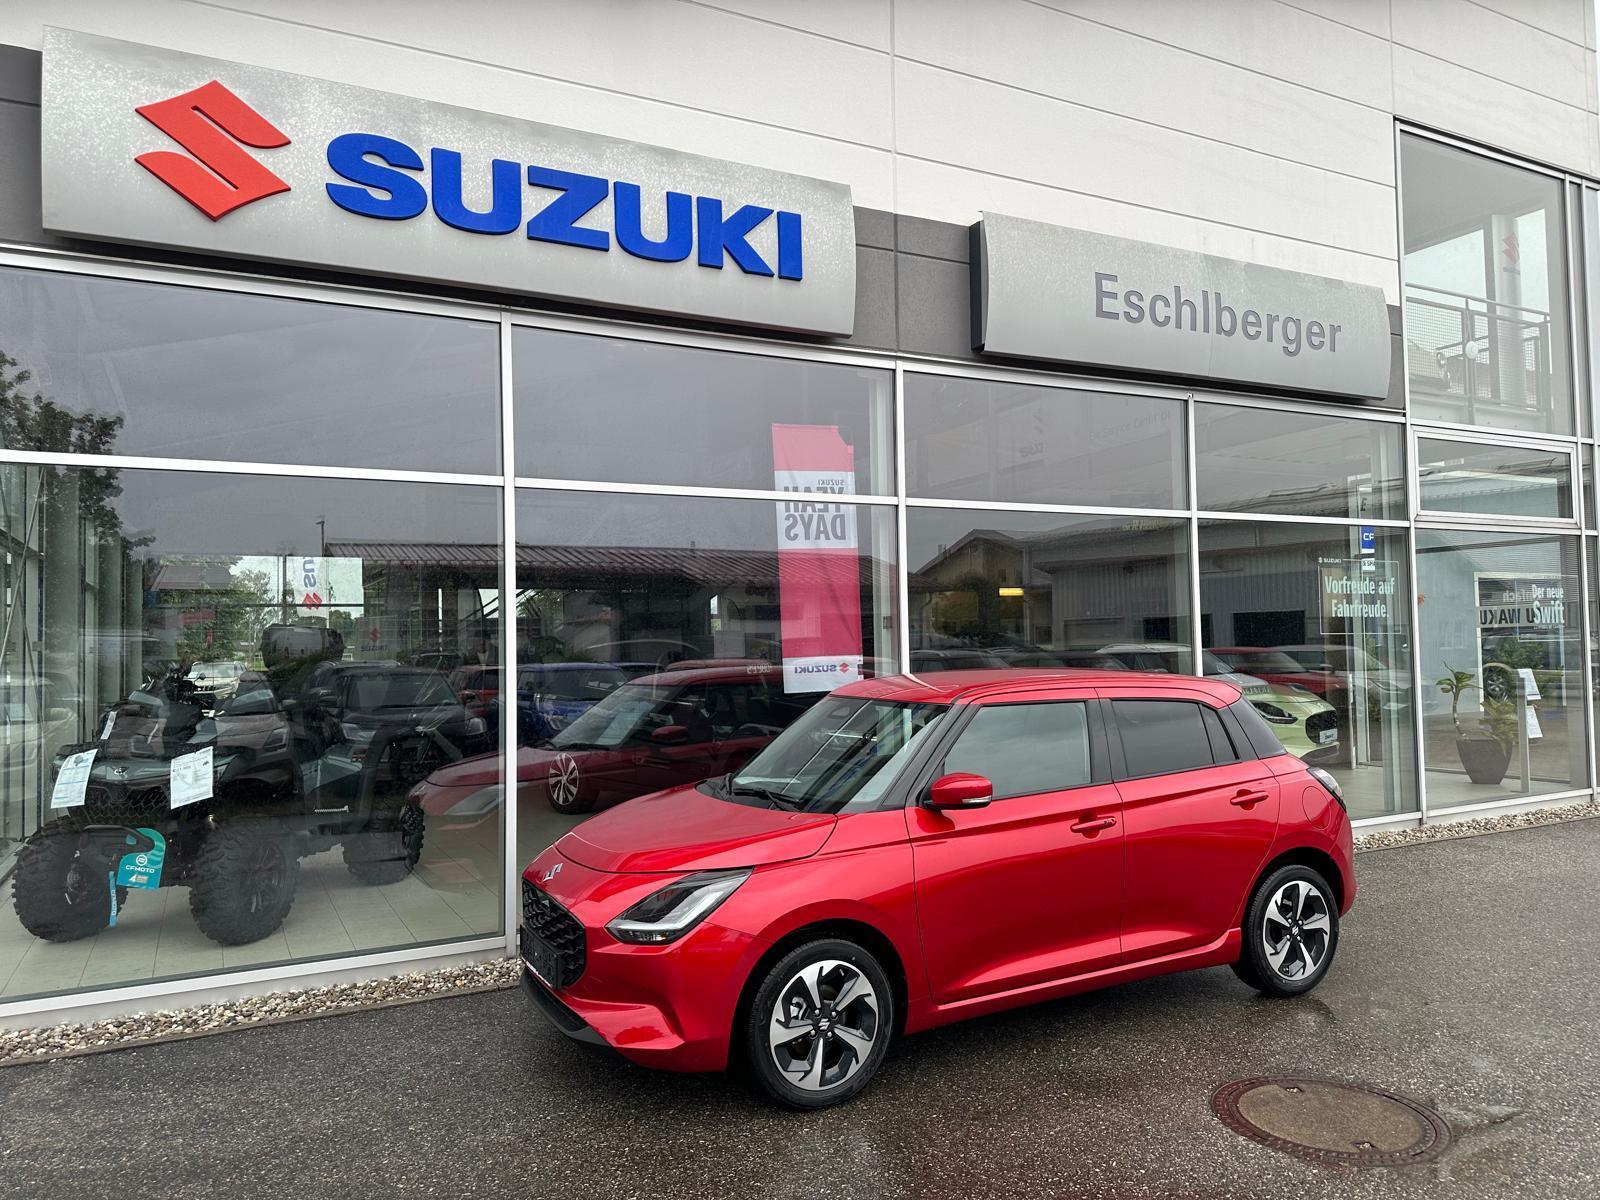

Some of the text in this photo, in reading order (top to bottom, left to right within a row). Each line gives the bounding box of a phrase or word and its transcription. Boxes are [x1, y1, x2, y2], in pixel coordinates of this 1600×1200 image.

[326, 132, 804, 282] SUZUKI
[1095, 271, 1342, 357] Eschlberger
[1324, 576, 1395, 595] Vorfreude auf
[1531, 584, 1564, 599] Der neue
[1331, 599, 1390, 618] Fahrfreude.
[1533, 601, 1565, 624] Swift
[125, 864, 155, 874] CFMOTO
